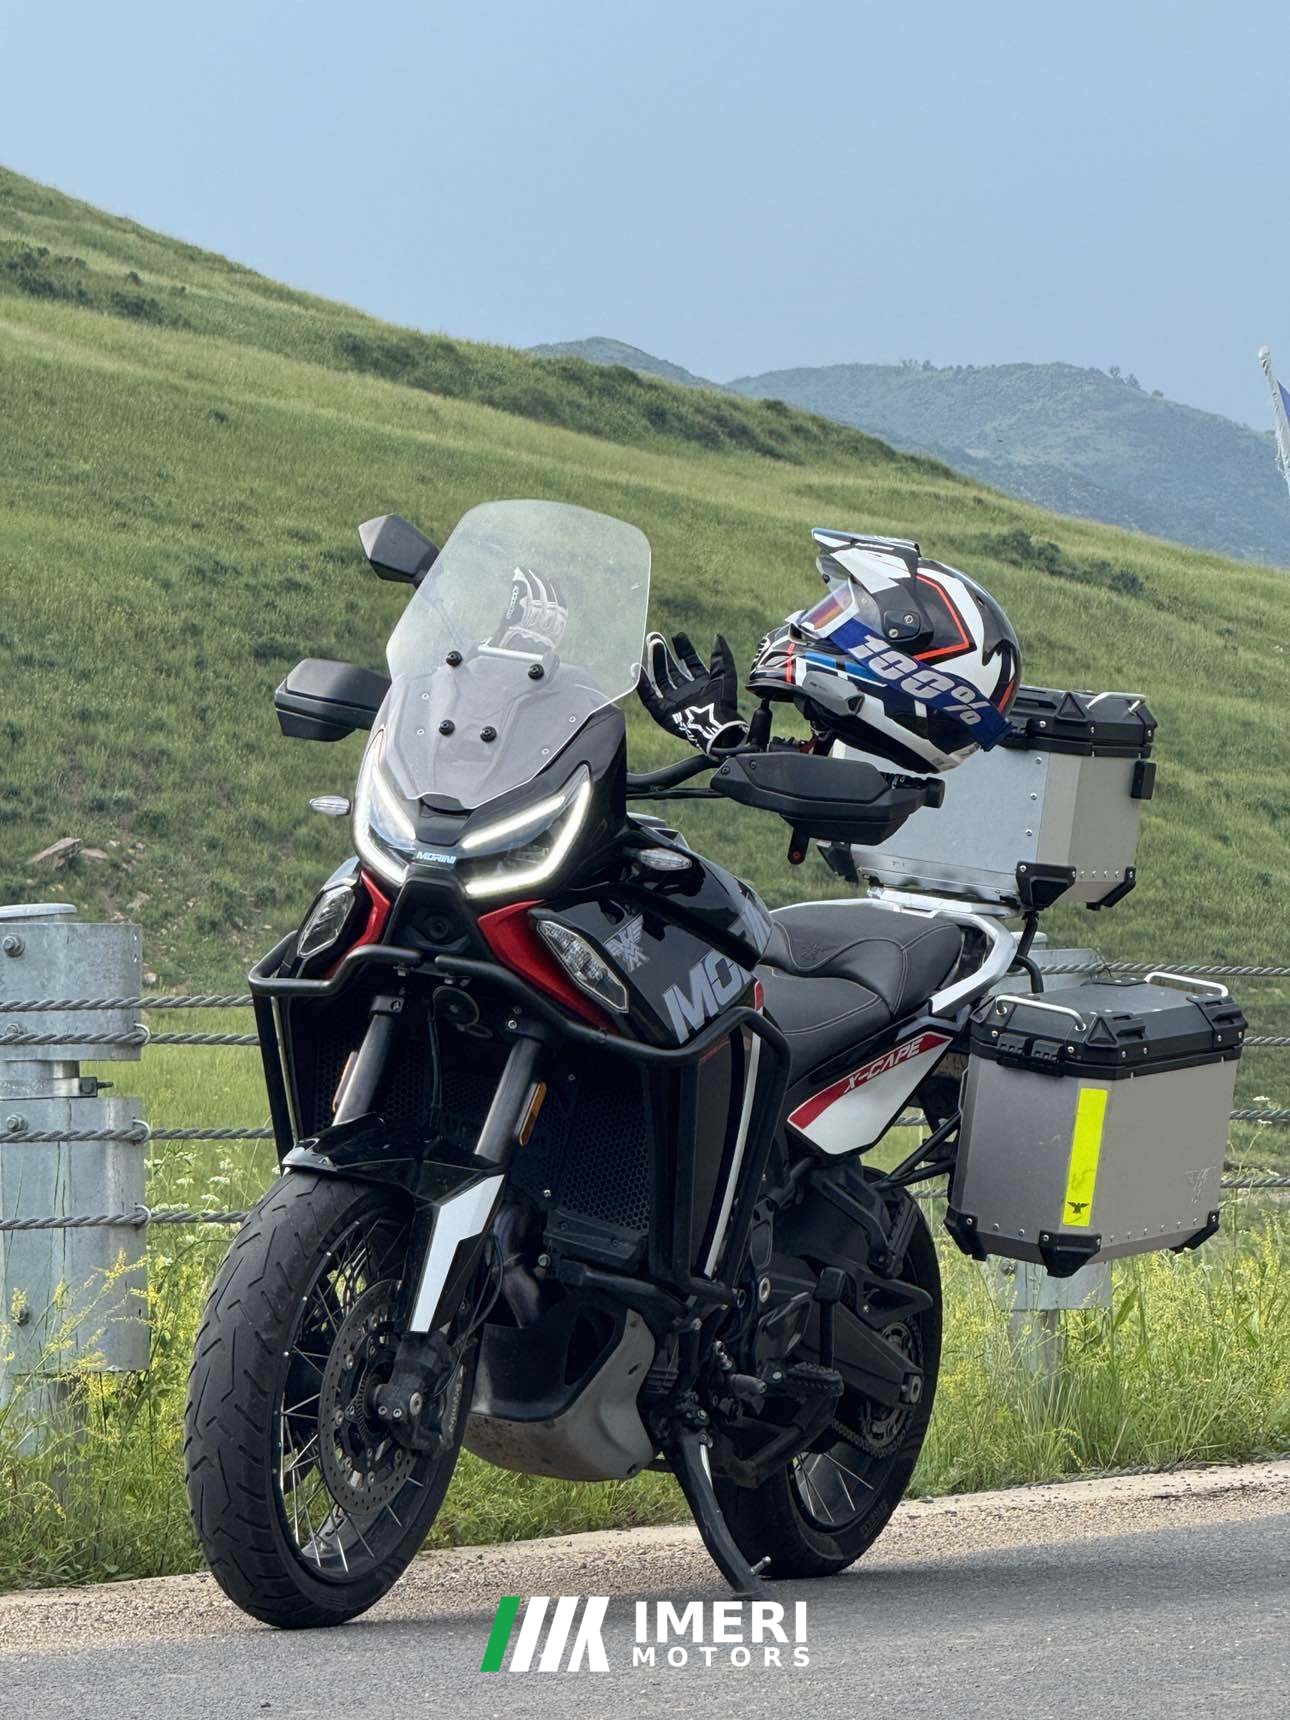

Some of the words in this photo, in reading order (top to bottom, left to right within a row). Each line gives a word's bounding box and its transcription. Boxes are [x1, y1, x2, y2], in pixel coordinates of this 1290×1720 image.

[848, 634, 991, 725] 100%
[416, 851, 456, 864] MORINI
[843, 1038, 924, 1093] X-CAPE
